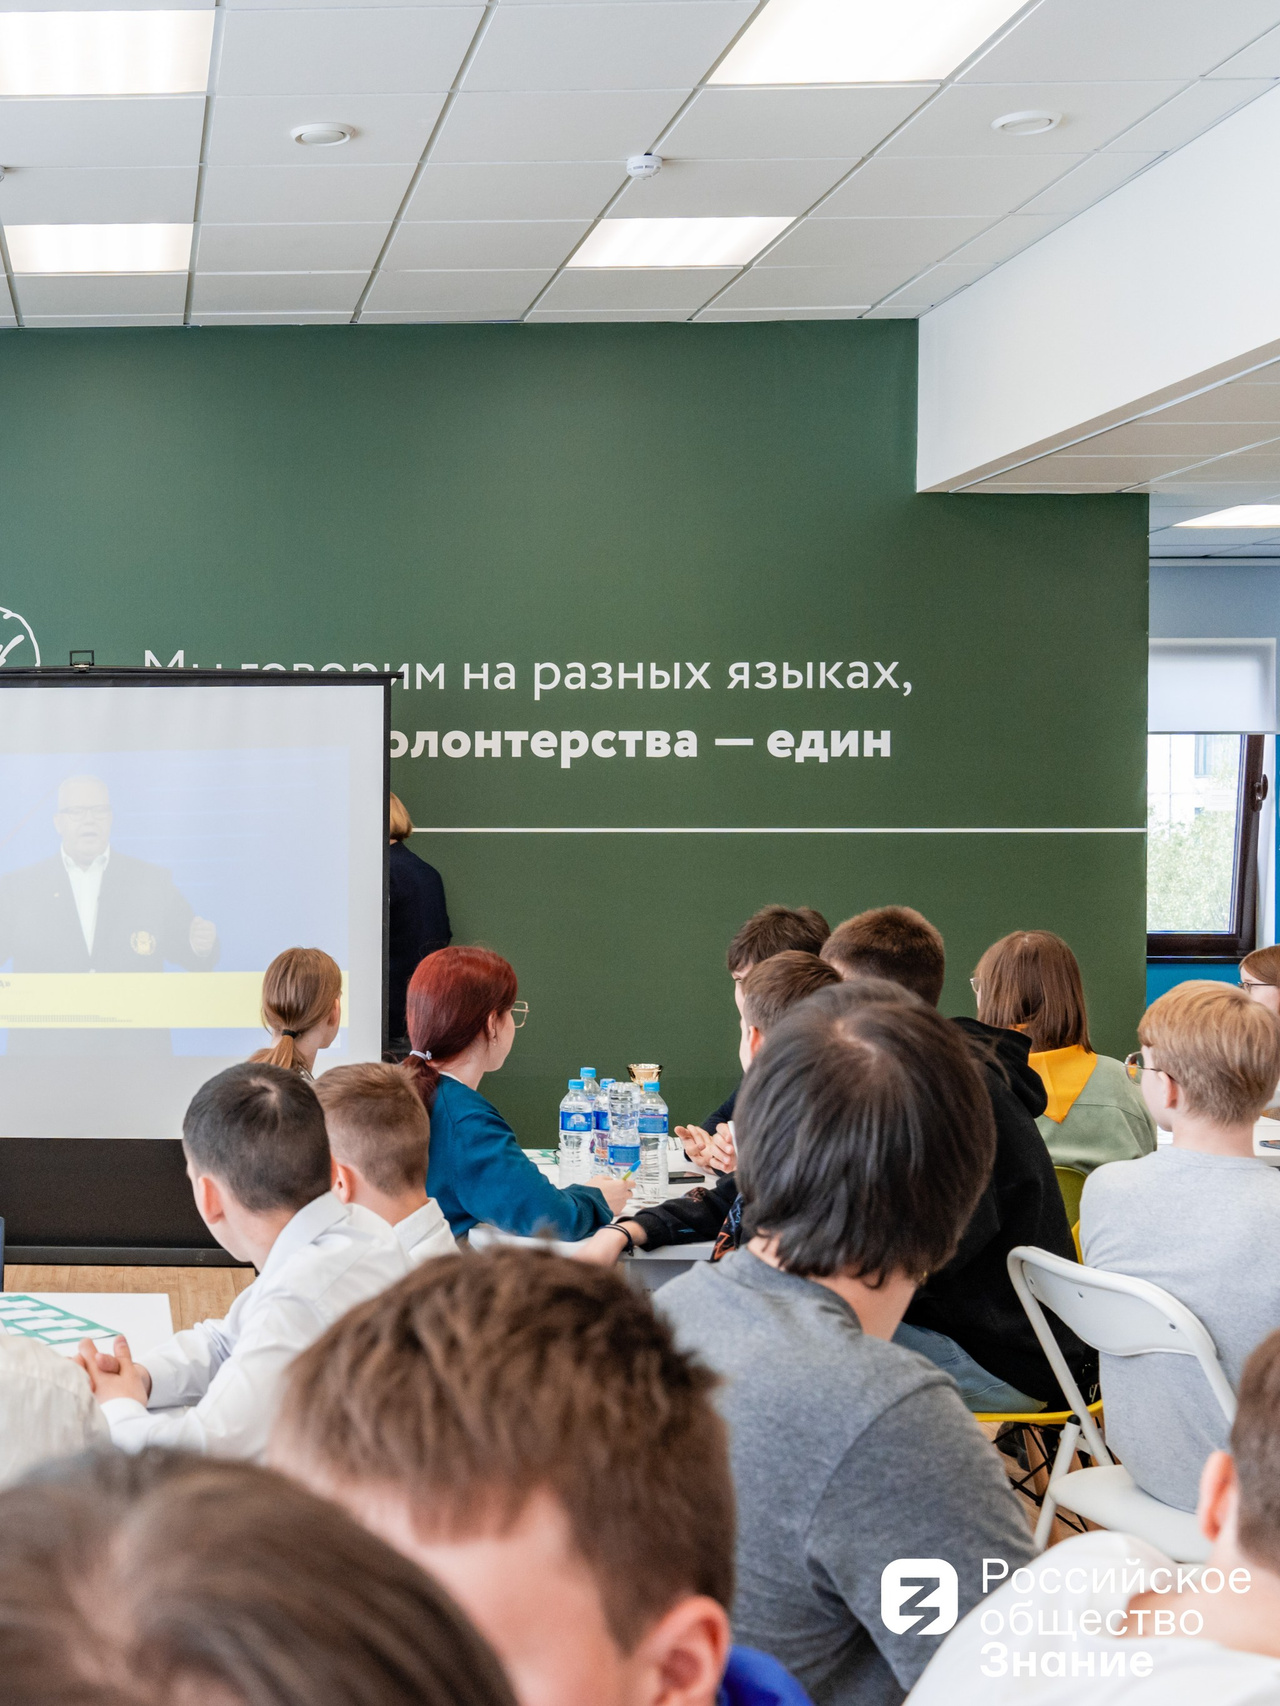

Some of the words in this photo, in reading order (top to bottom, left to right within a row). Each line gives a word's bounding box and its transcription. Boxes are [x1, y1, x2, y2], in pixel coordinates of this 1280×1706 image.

[463, 663, 516, 690] на
[534, 662, 711, 700] разных
[727, 662, 913, 697] языках,
[767, 729, 891, 763] един
